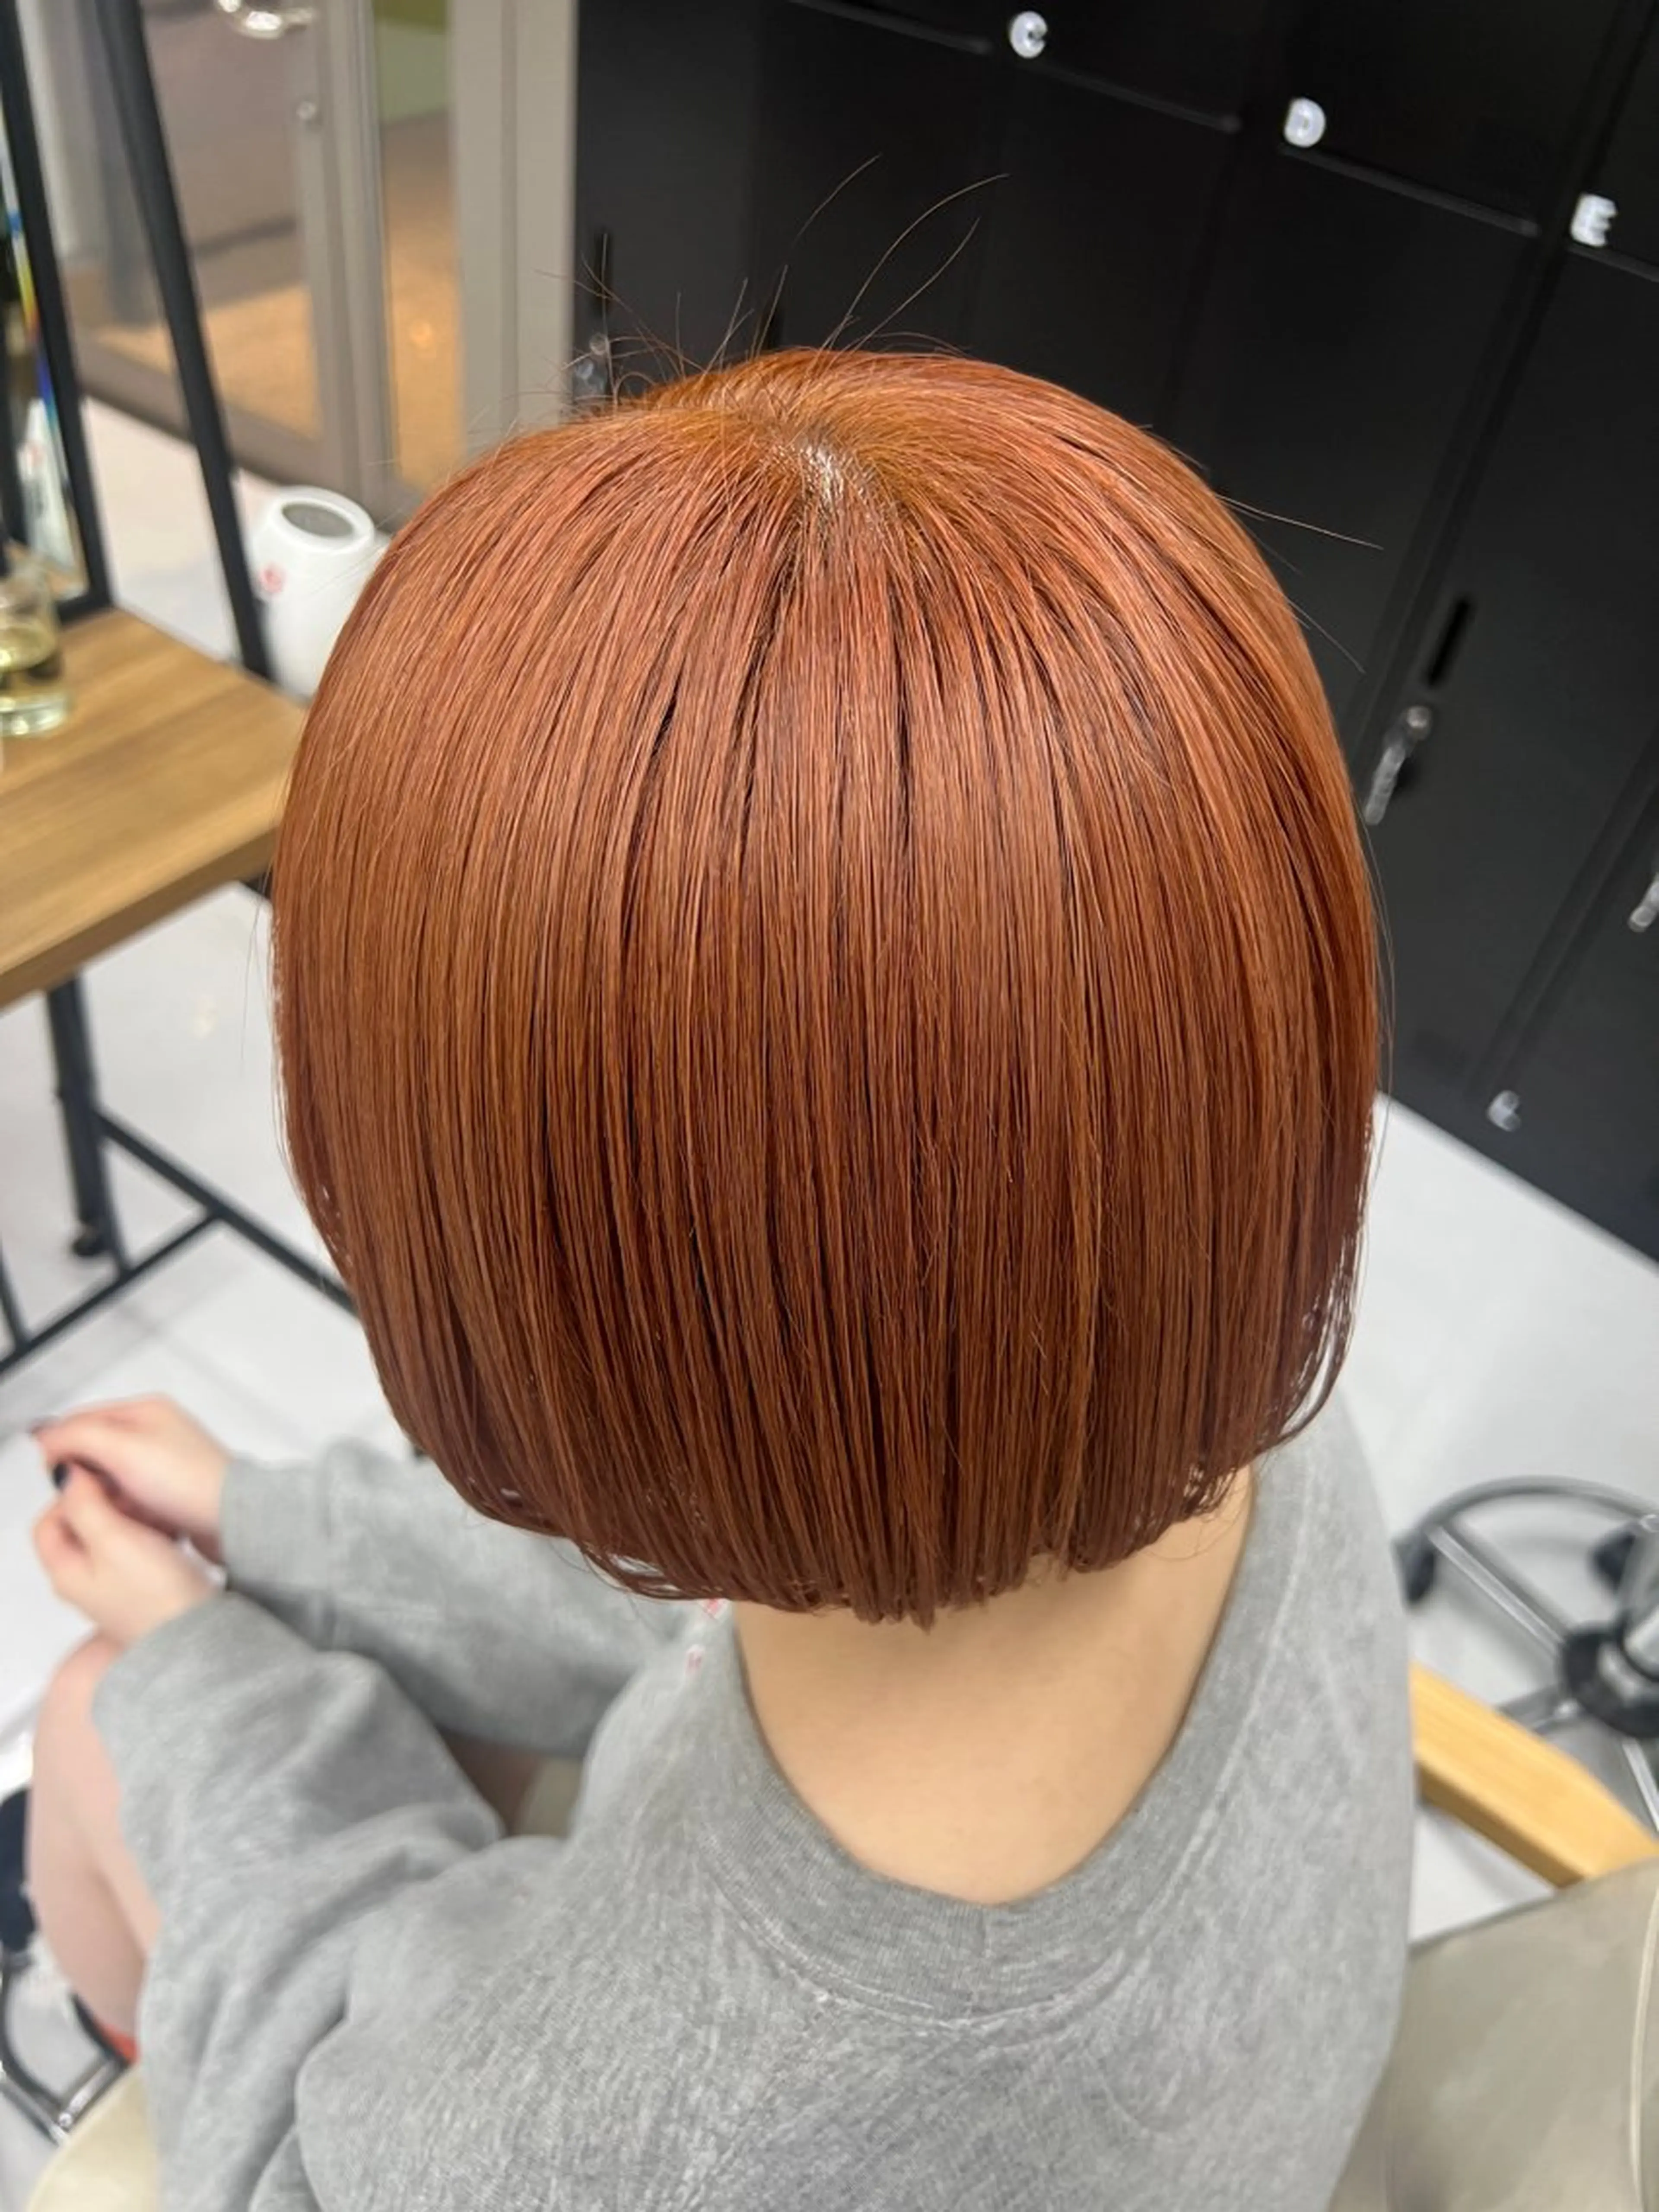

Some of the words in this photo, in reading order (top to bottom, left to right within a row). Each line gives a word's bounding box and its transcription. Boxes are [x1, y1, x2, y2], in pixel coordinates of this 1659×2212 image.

[1010, 12, 1047, 58] C
[1284, 98, 1325, 147] D
[1571, 194, 1617, 247] E
